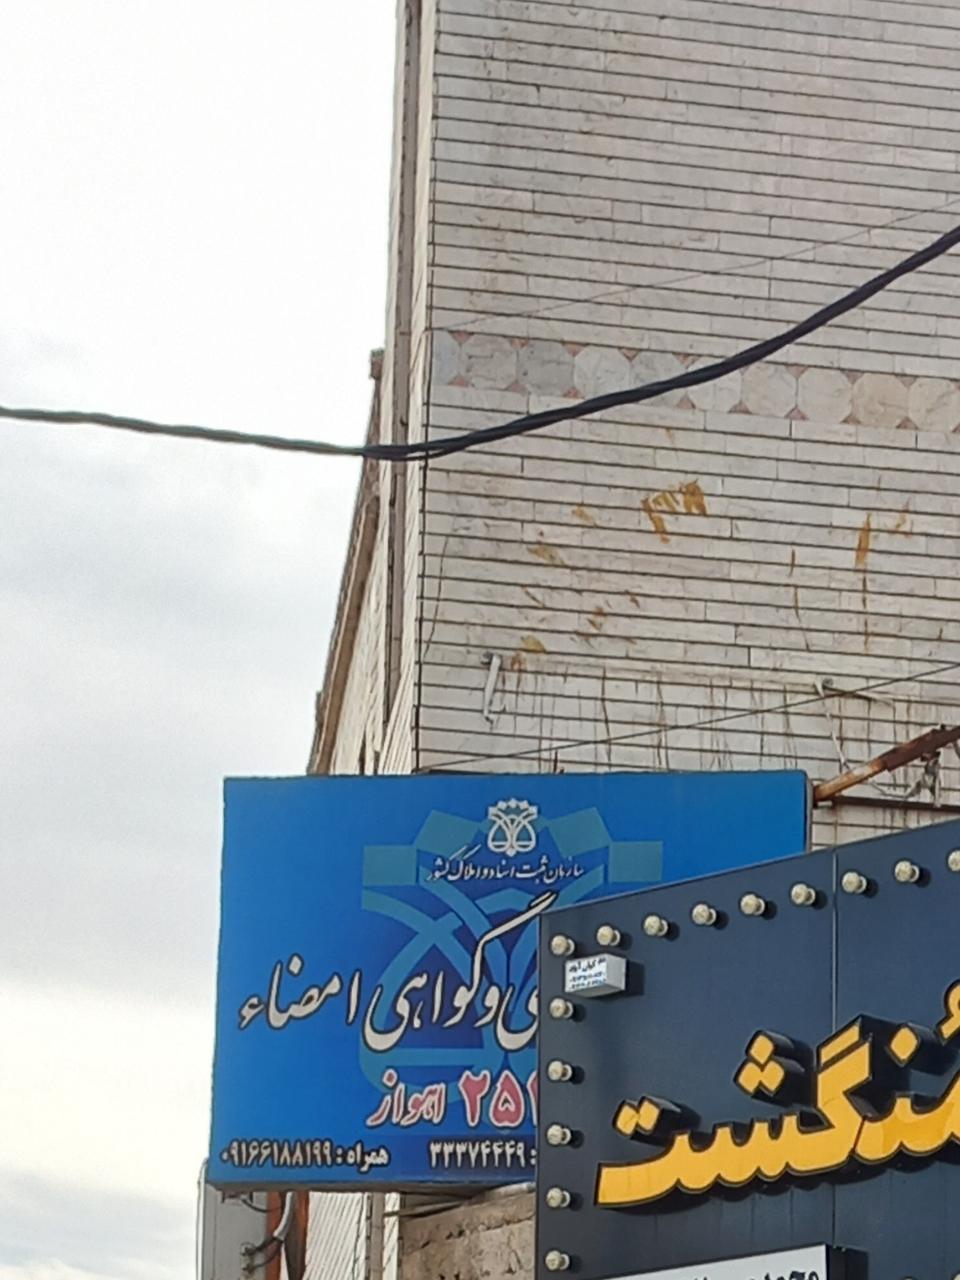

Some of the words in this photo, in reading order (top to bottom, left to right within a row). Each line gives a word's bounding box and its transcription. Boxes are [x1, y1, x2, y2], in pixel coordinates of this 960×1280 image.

[238, 954, 362, 1030] امضاء
[366, 1068, 446, 1127] اهواز
[458, 1069, 538, 1127] ۲۵
